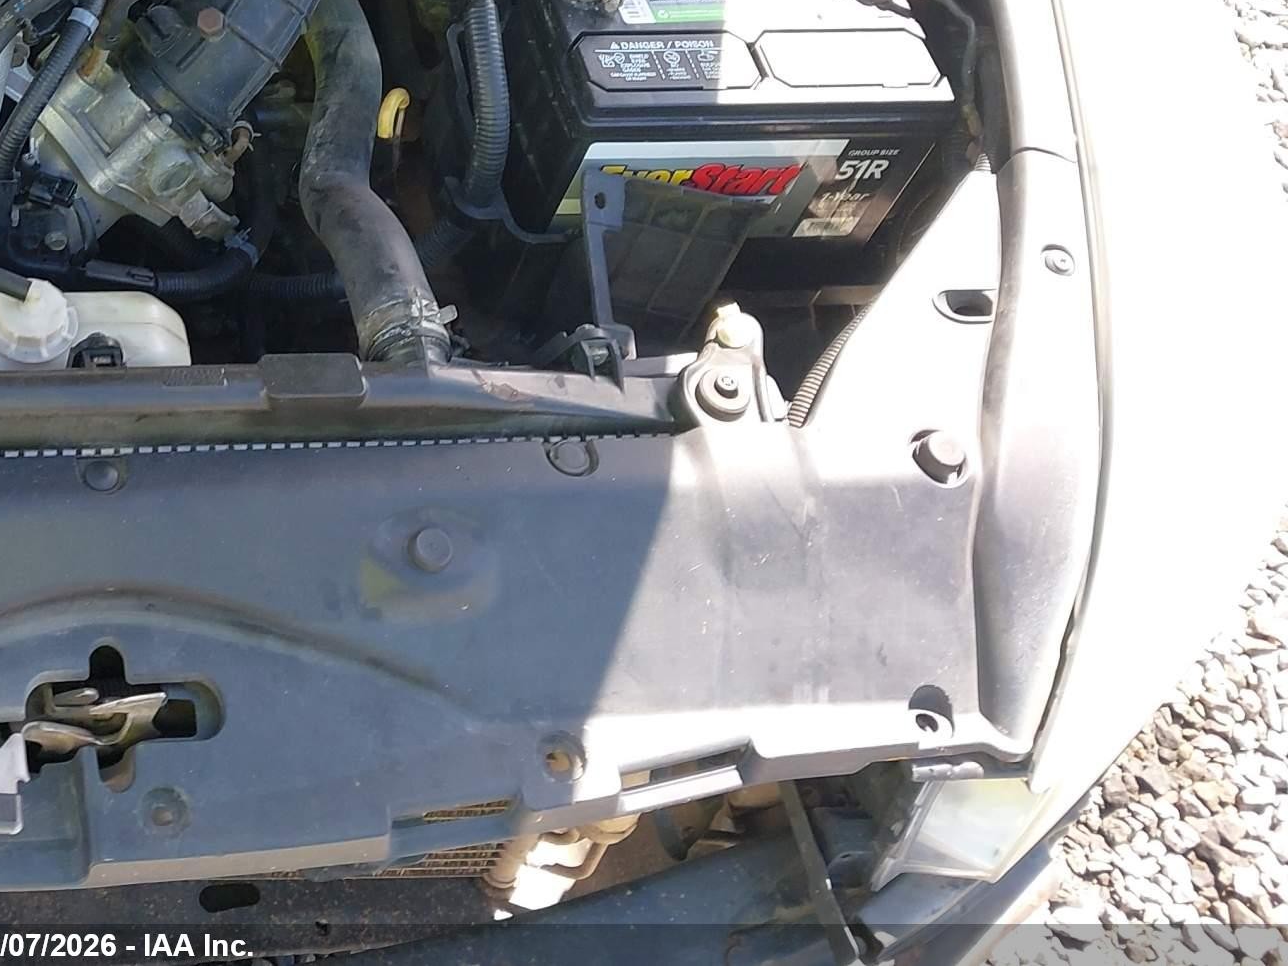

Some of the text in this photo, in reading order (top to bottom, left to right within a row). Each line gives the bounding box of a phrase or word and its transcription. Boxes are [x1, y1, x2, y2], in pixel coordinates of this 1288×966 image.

[620, 41, 665, 50] DANGER
[675, 40, 714, 49] POISON
[848, 148, 900, 157] GROUP SIZE
[835, 159, 890, 181] 51R
